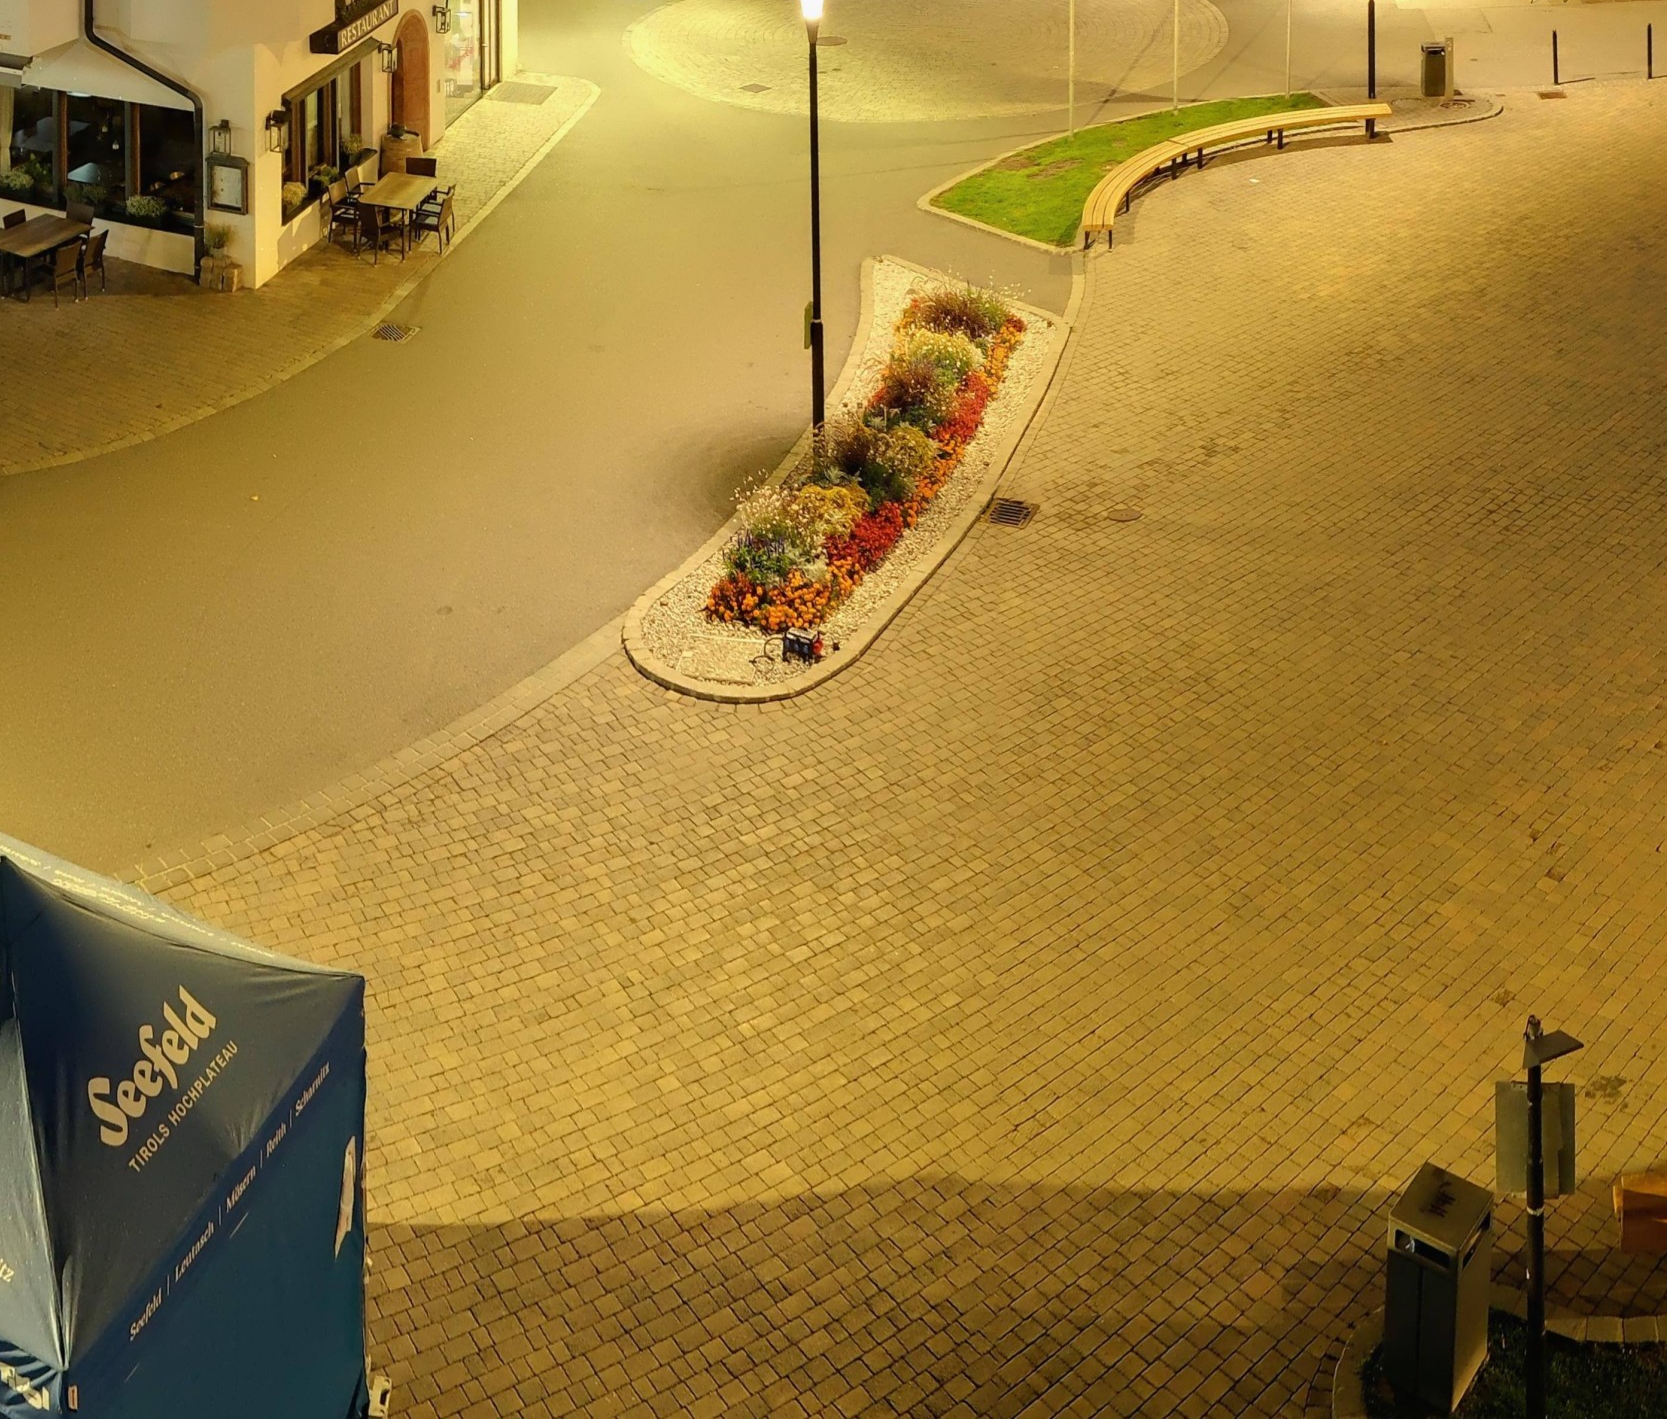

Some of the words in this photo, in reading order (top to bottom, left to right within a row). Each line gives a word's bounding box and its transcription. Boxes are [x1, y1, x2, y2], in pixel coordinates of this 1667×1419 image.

[87, 984, 218, 1148] Seefeld
[128, 1123, 171, 1174] TIROLS
[167, 1039, 240, 1126] HOCHPLATEAU
[129, 1288, 162, 1342] Seefeld
[174, 1220, 215, 1283] Leutasch
[225, 1165, 257, 1213] Mösern
[265, 1122, 288, 1158] Reith
[294, 1061, 331, 1117] Scharnitz
